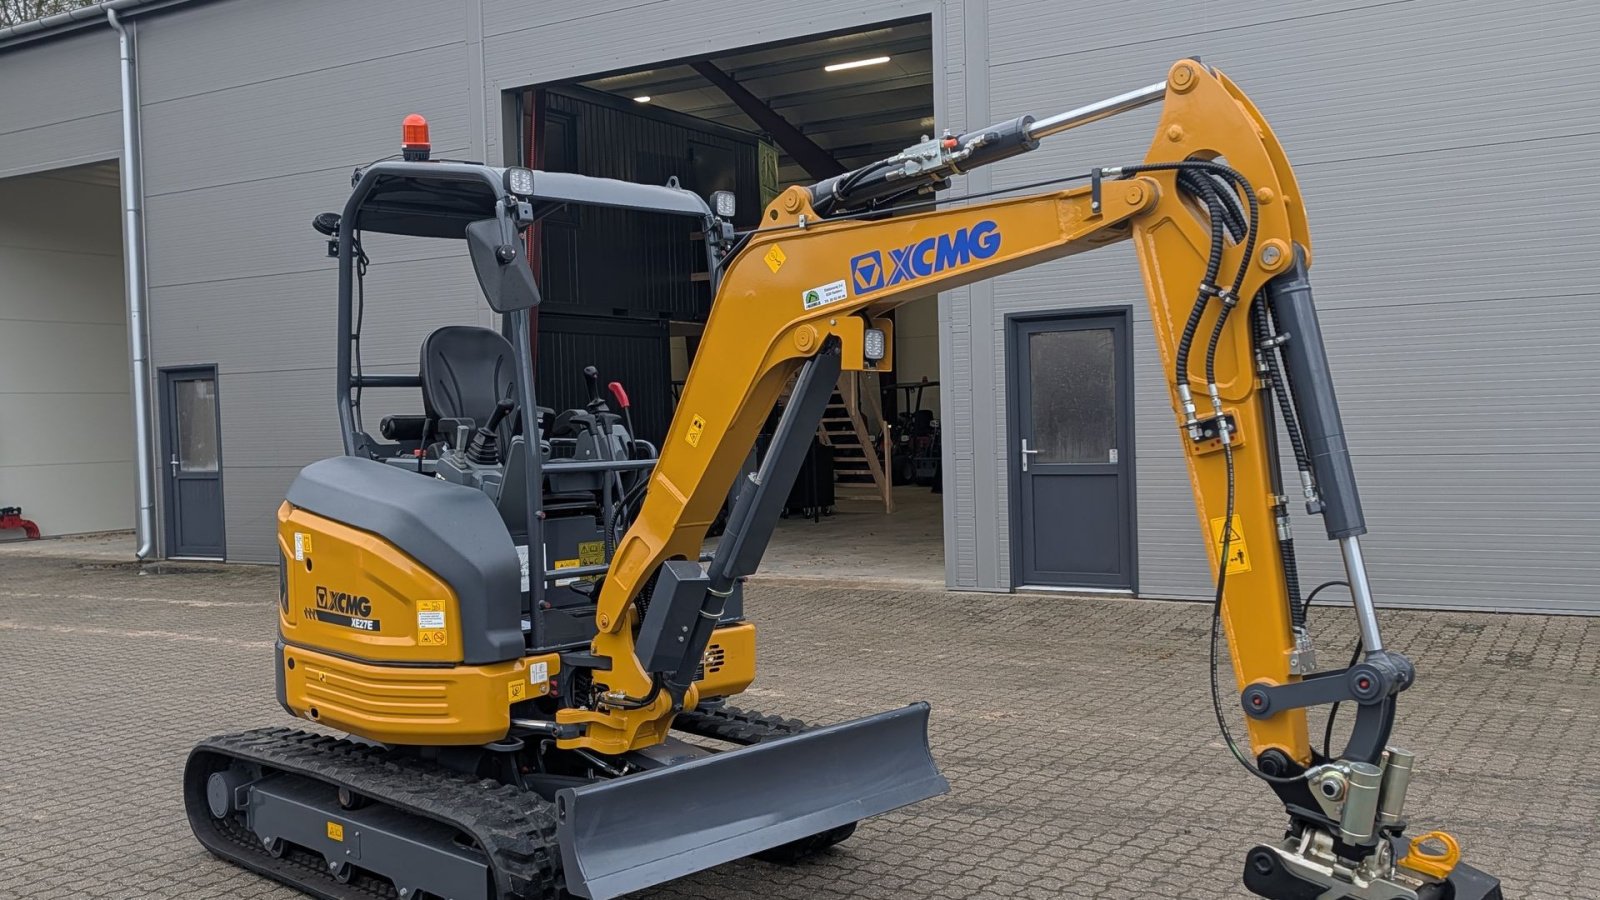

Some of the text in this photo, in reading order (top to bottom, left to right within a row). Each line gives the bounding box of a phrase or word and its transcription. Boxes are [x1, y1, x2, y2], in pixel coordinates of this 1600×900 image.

[886, 220, 1001, 287] XCMG
[328, 591, 371, 617] XCMG
[351, 618, 373, 630] XE27E
